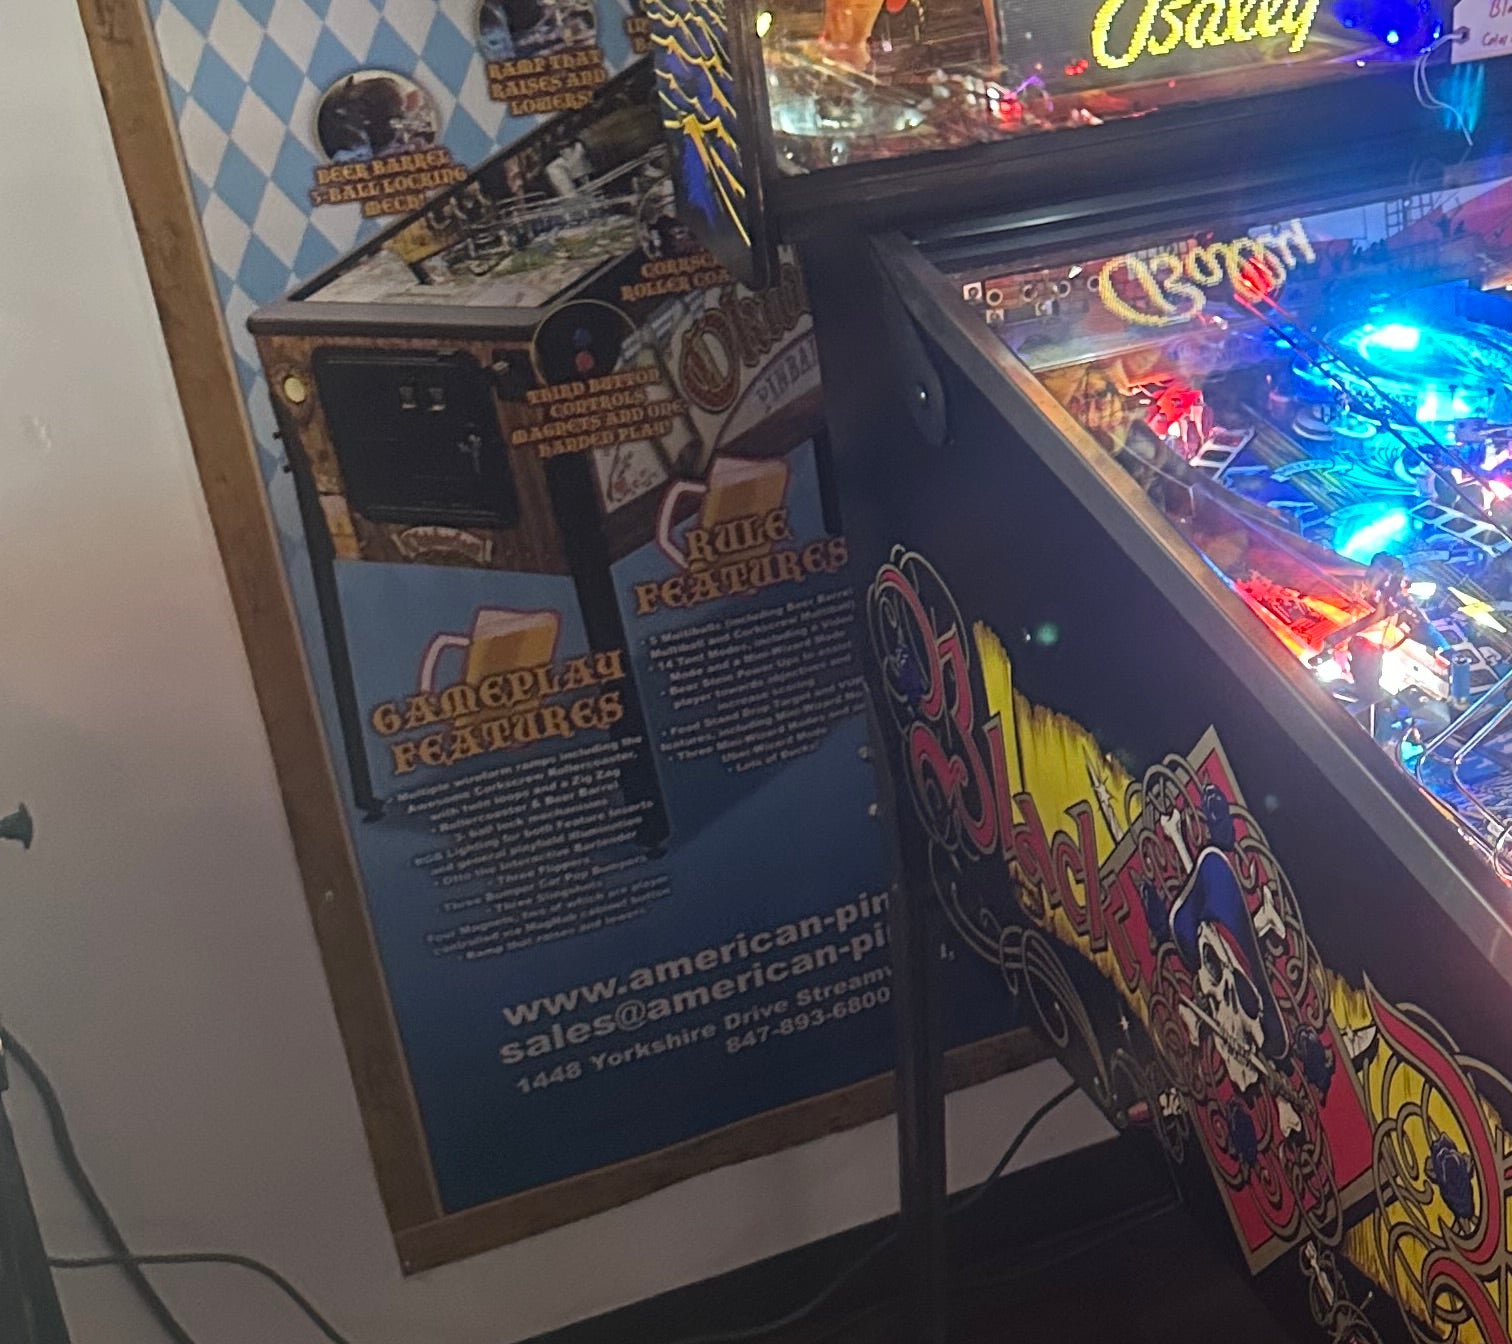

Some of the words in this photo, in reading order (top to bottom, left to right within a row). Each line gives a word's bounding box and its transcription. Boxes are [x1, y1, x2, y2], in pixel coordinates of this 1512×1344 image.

[488, 57, 545, 80] RAMP
[491, 76, 562, 99] RAISES
[566, 69, 606, 88] AND
[317, 163, 369, 184] BEER
[372, 149, 449, 176] BARREL
[383, 166, 467, 193] LOCKING
[527, 380, 586, 405] THIRD
[589, 368, 660, 393] BUTTON
[551, 390, 646, 418] CONTROLS
[511, 417, 601, 446] MAGNETS
[606, 408, 644, 431] AND
[686, 508, 794, 563] RULE
[634, 535, 851, 617] FEATURES
[372, 650, 626, 739] GAMEPLAY
[391, 692, 625, 776] FEATURES
[726, 987, 892, 1056] 847-893-6800
[516, 1061, 583, 1094] 1448
[591, 1021, 718, 1078] Yorkshire
[724, 998, 789, 1033] Drive
